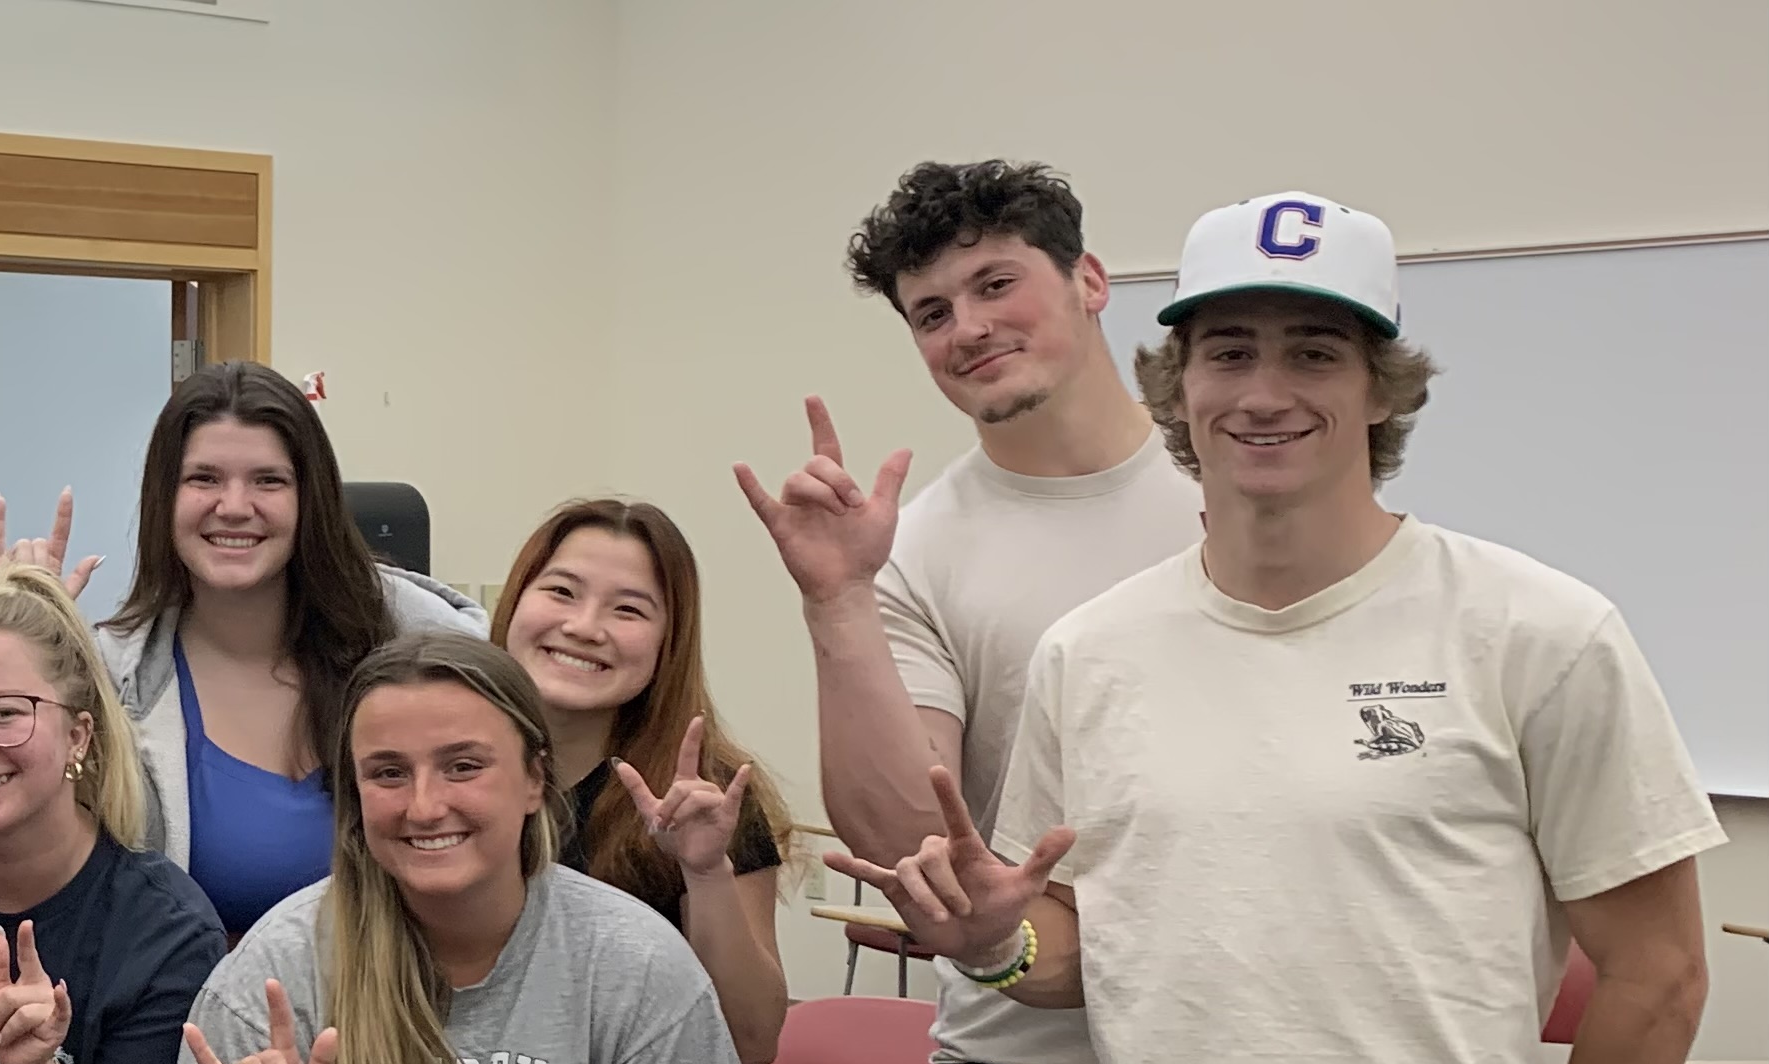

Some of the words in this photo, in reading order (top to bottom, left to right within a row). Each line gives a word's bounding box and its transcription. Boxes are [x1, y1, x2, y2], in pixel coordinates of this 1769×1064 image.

[1256, 200, 1326, 261] C
[1349, 682, 1382, 696] Wild
[1386, 680, 1447, 694] Wonders
